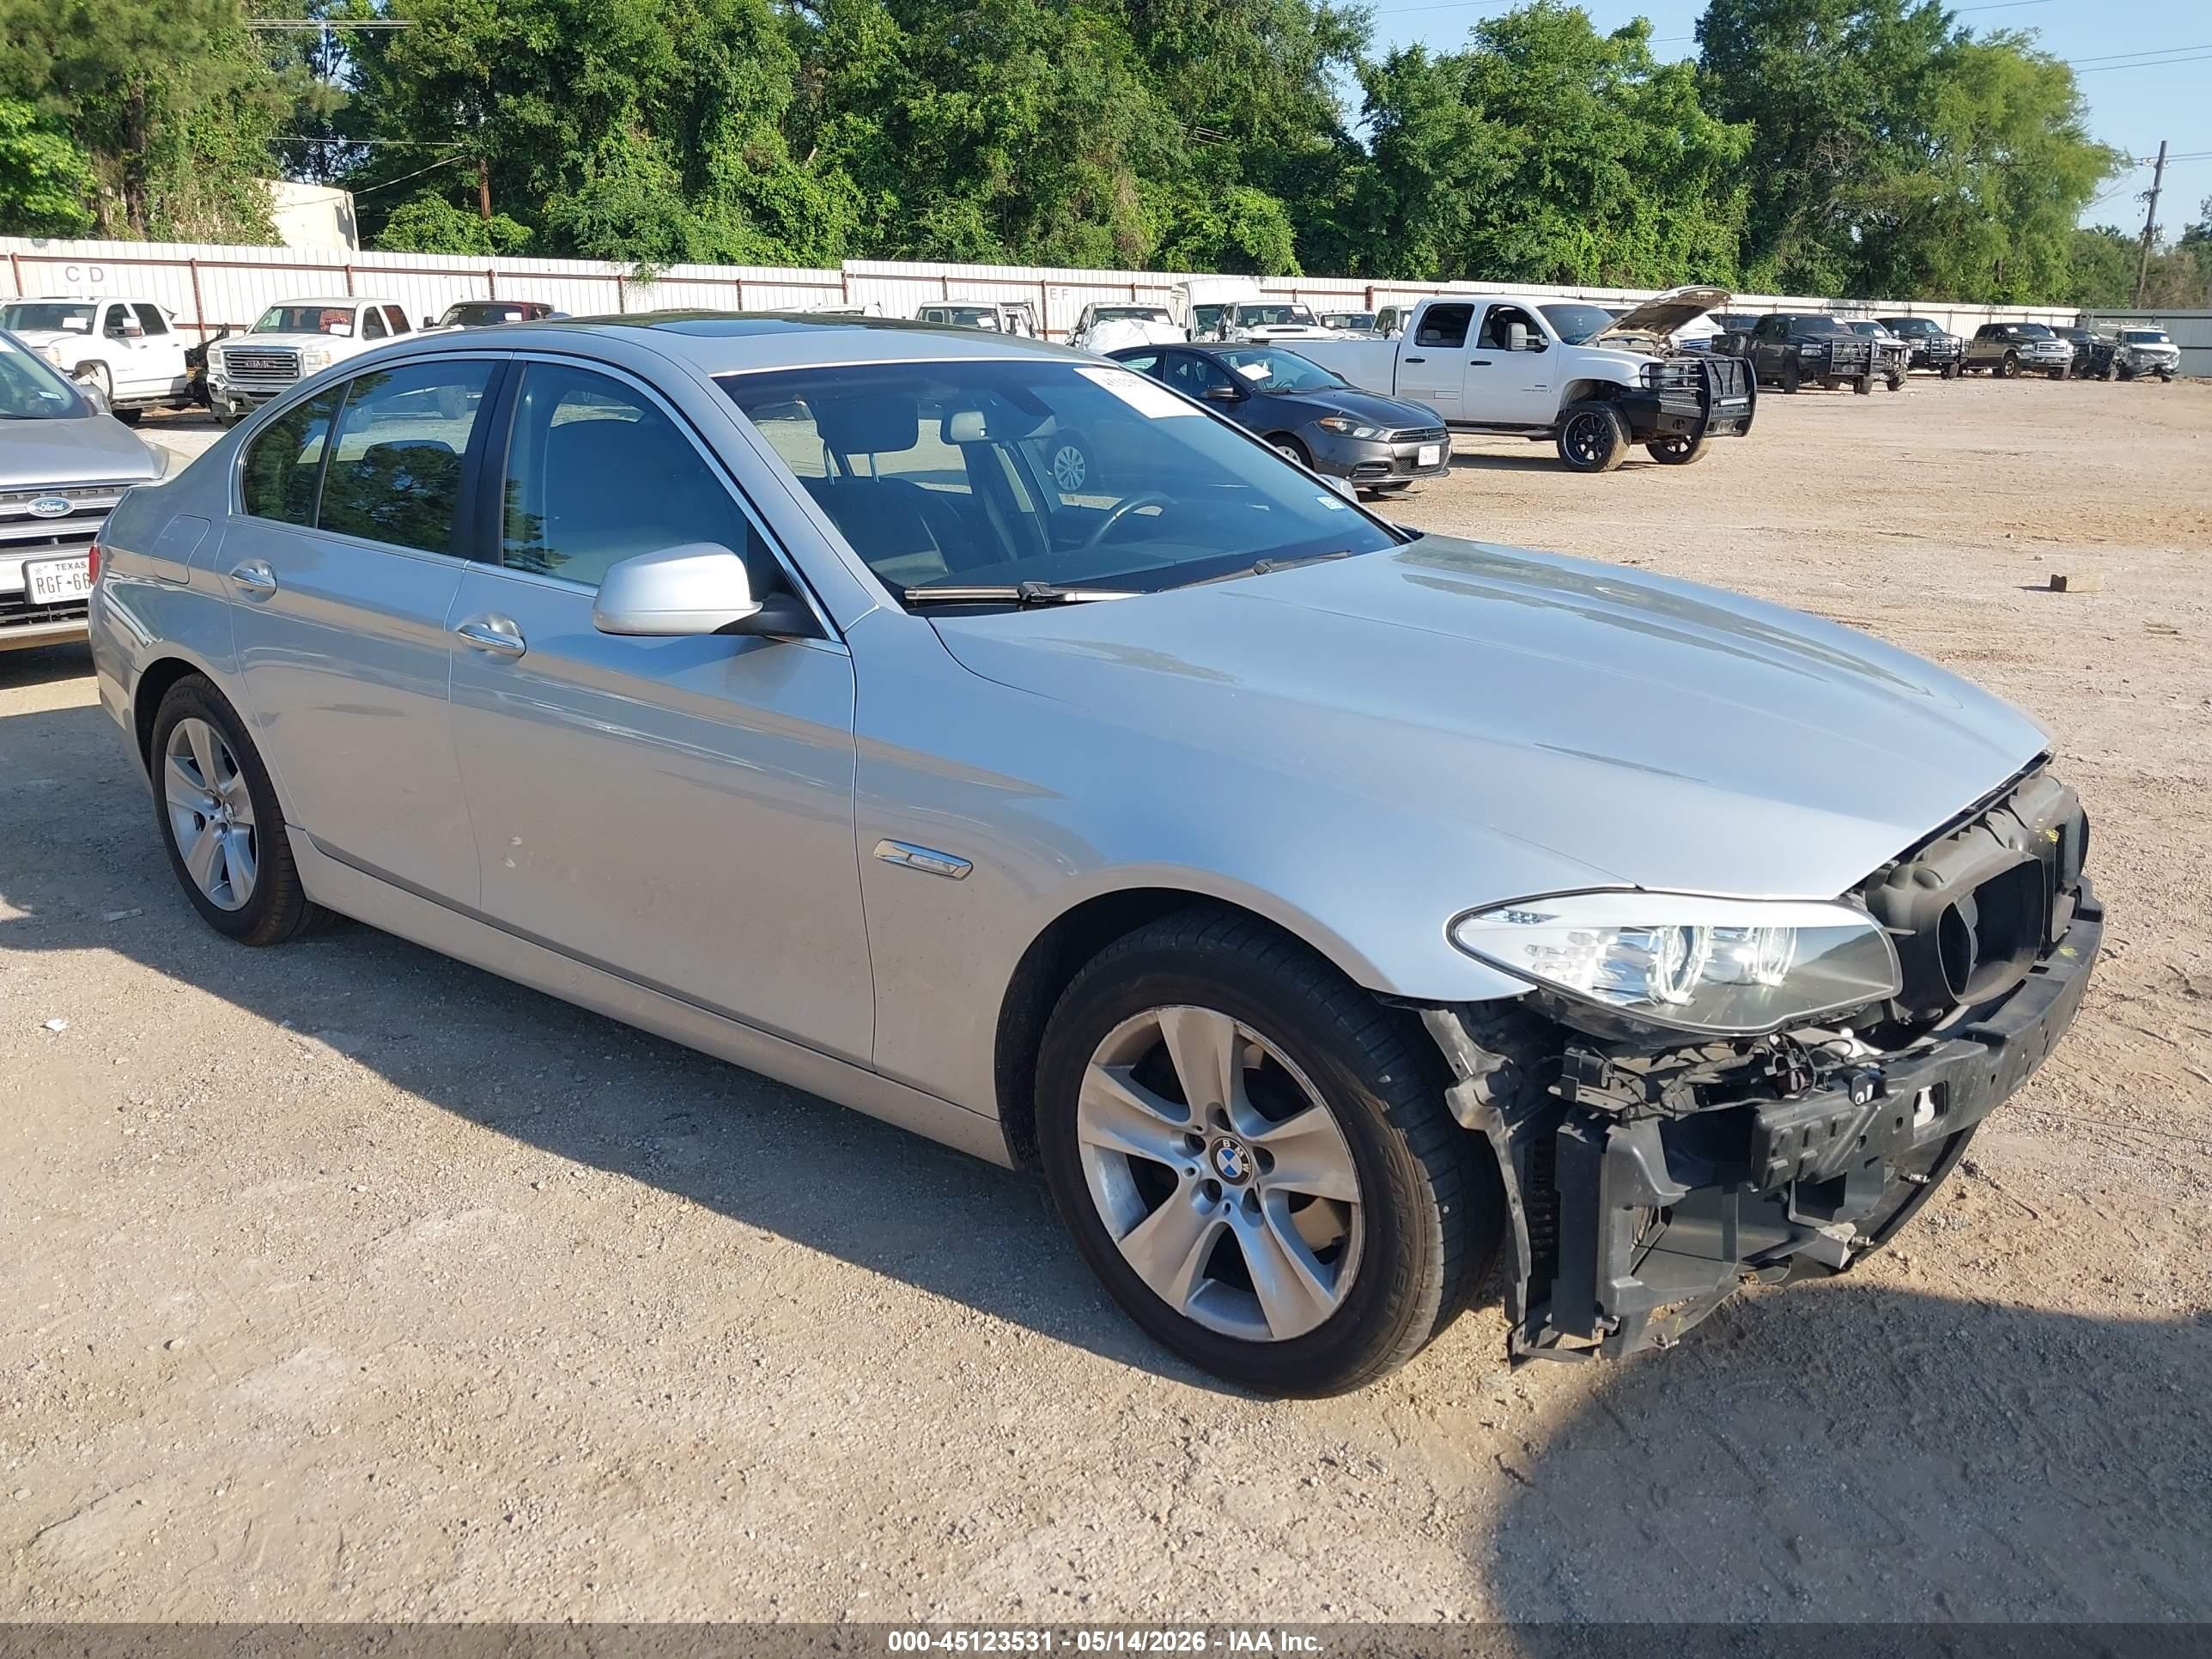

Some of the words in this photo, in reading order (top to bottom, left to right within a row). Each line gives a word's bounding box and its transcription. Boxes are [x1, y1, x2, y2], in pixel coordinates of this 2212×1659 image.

[40, 501, 64, 512] Ford
[55, 561, 87, 571] TEXAS
[1222, 1139, 1250, 1174] BMW
